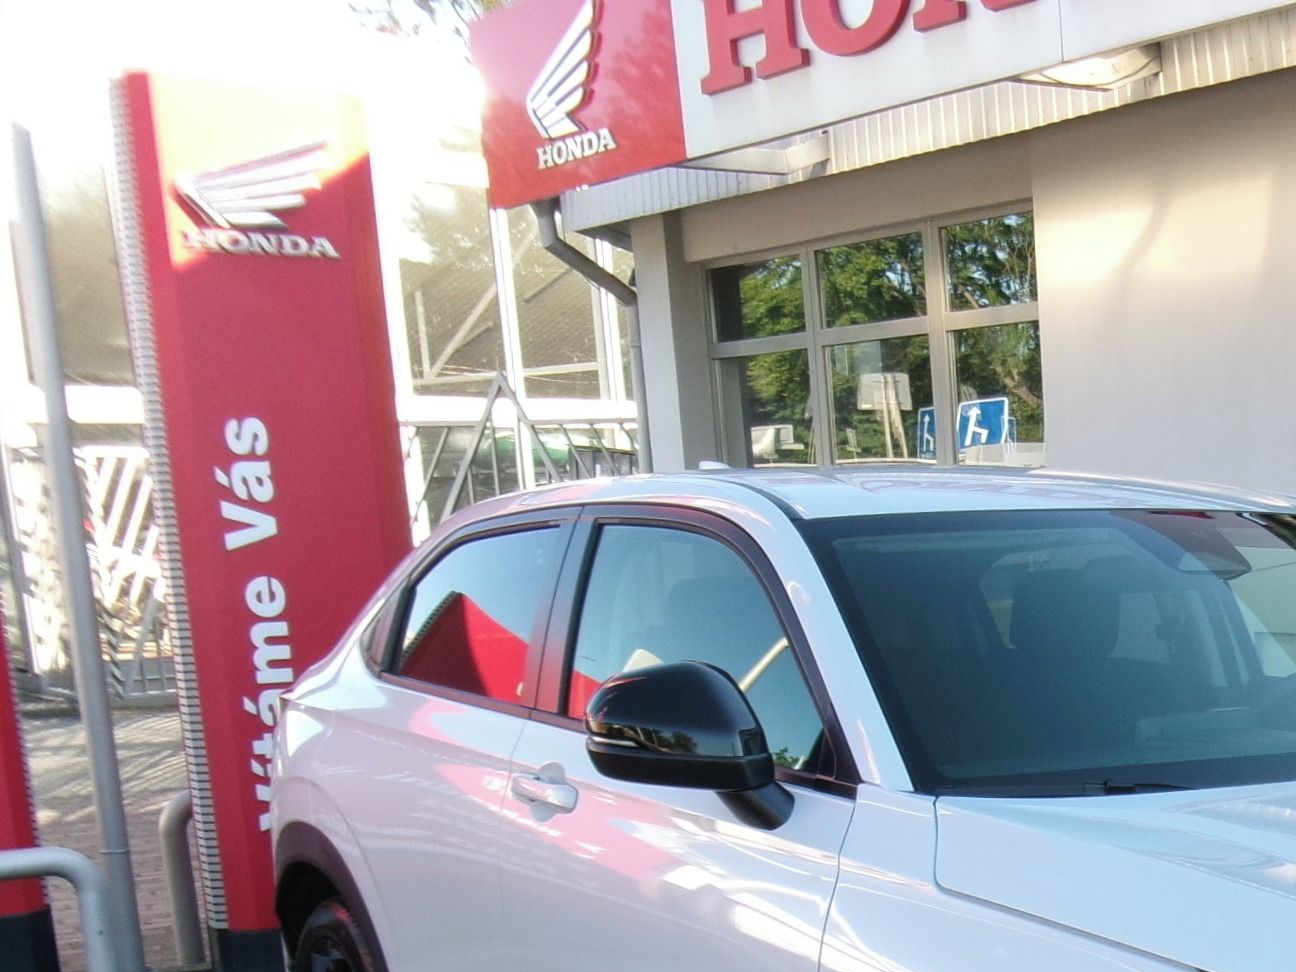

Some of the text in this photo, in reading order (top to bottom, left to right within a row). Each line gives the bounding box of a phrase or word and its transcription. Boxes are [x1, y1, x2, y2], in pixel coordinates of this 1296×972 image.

[536, 127, 617, 170] HONDA
[180, 227, 342, 260] HONDA
[214, 416, 278, 551] Vás
